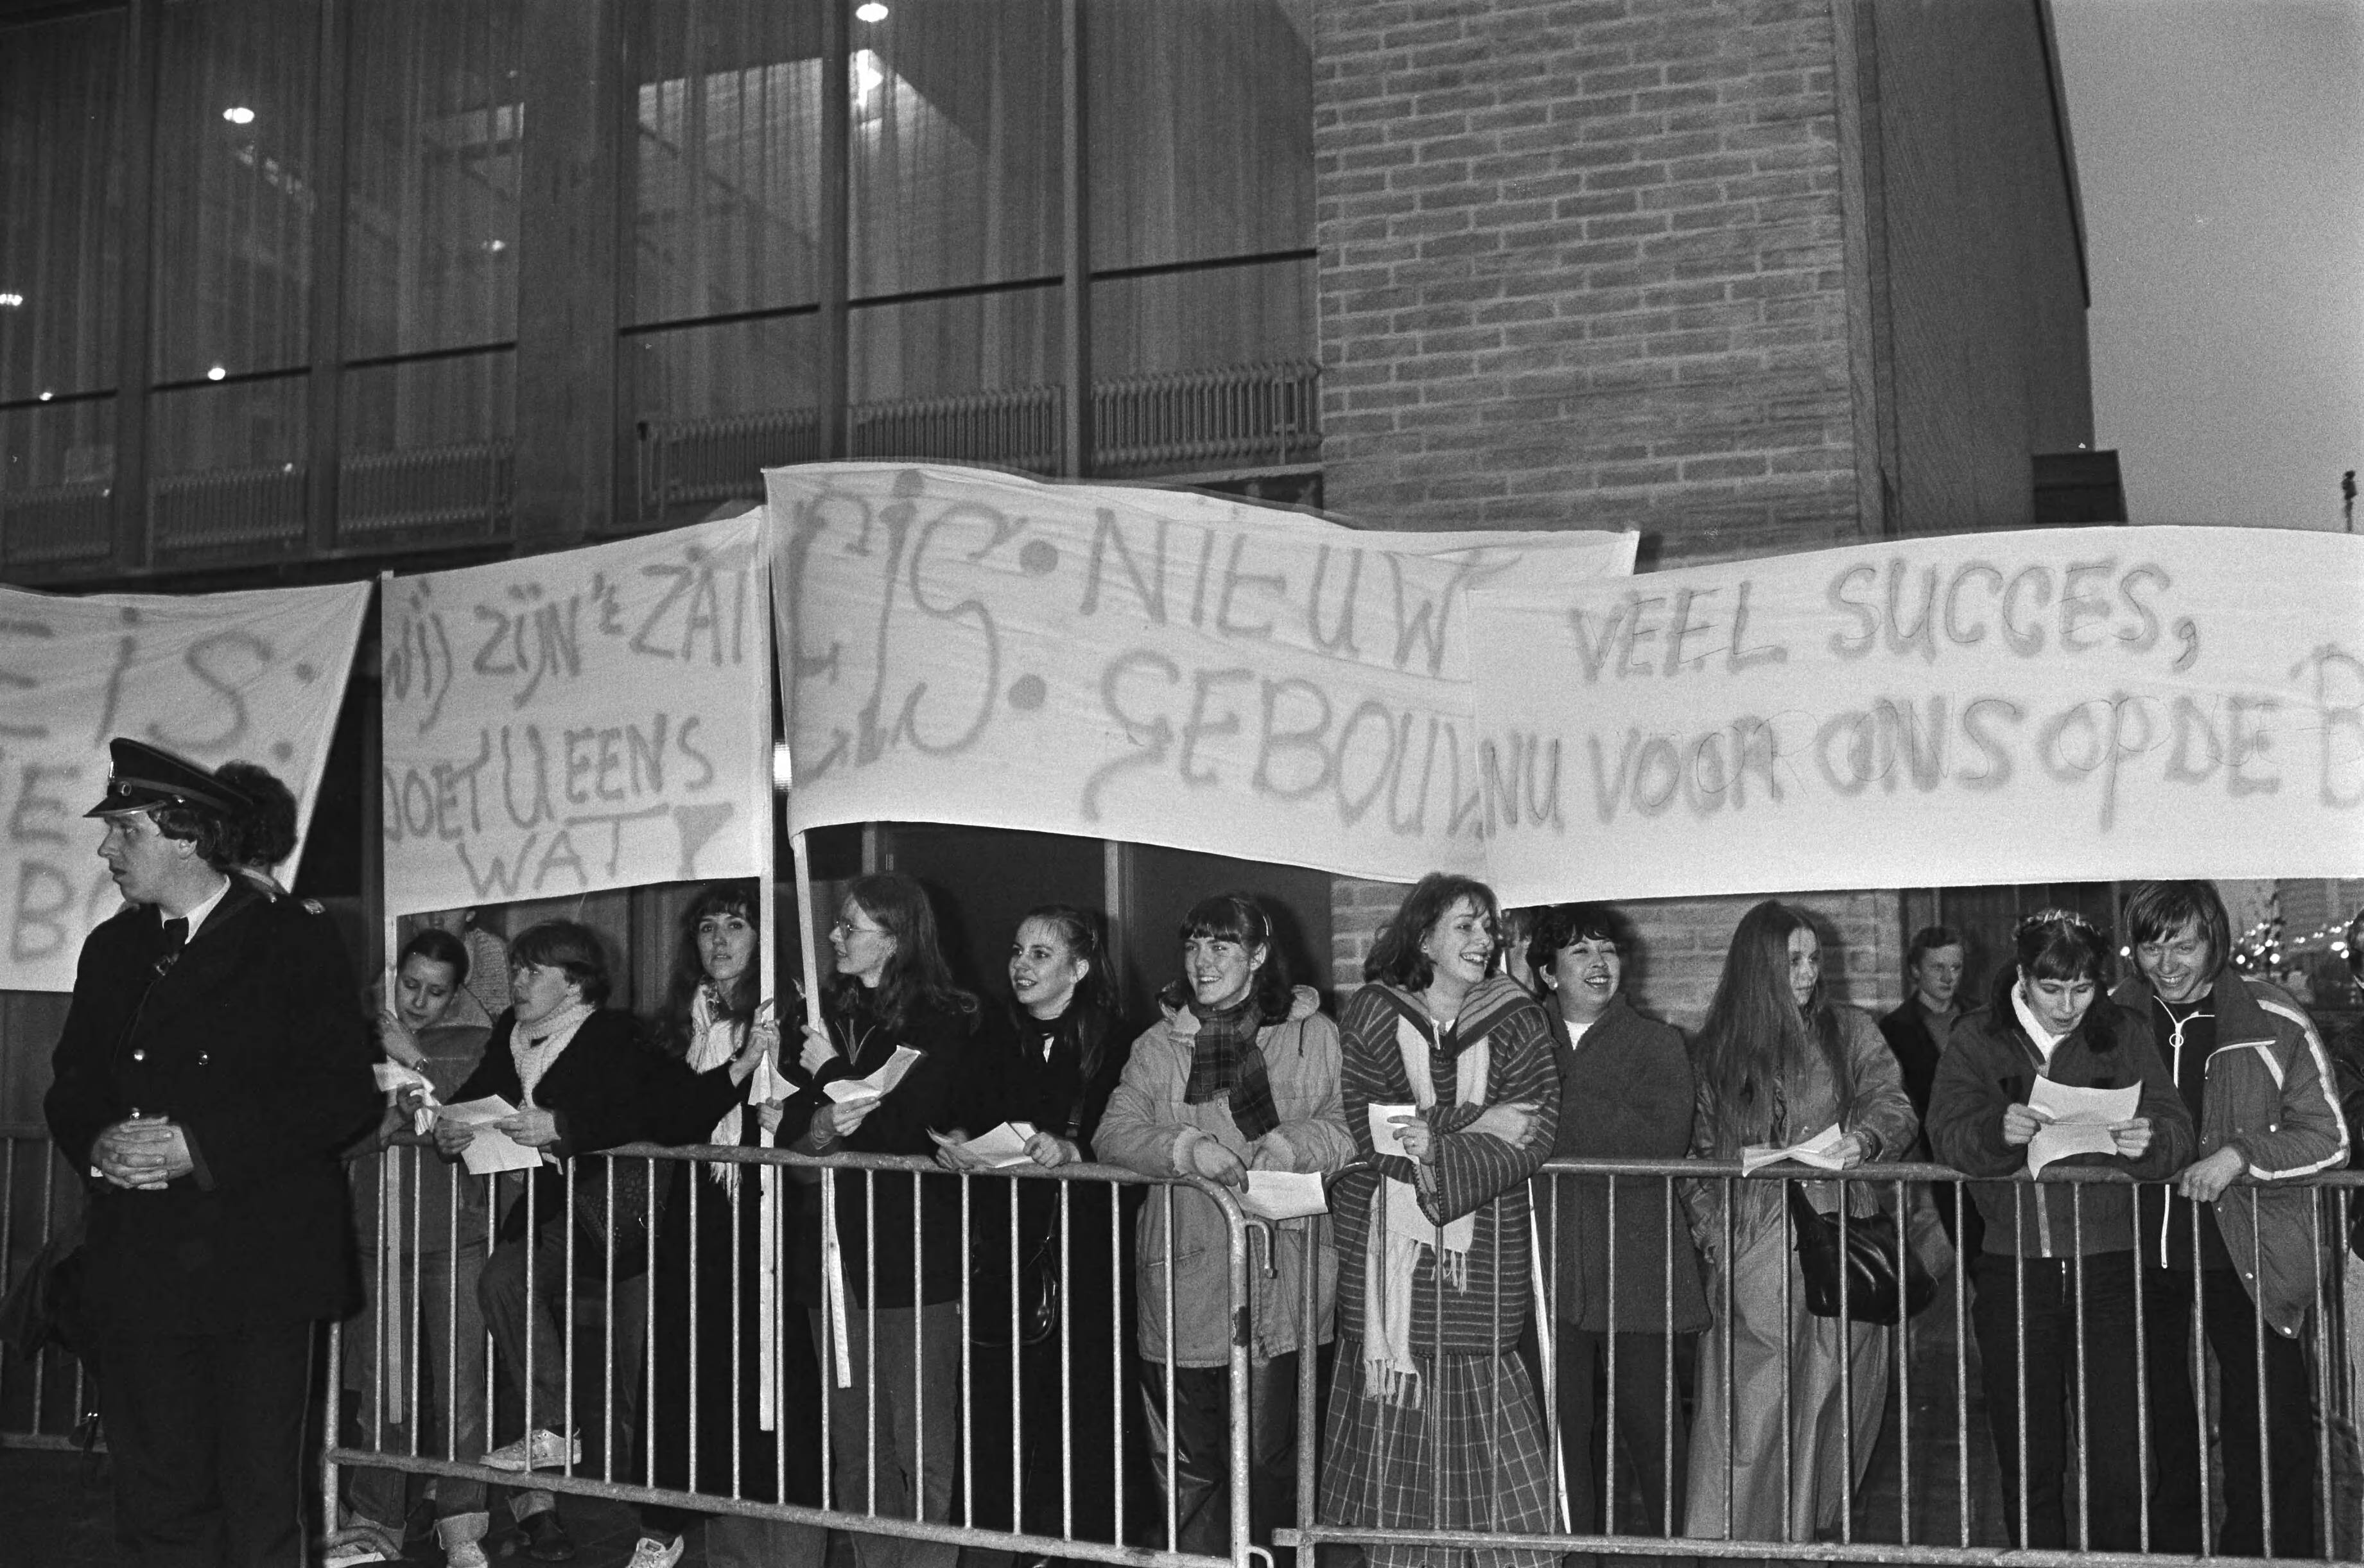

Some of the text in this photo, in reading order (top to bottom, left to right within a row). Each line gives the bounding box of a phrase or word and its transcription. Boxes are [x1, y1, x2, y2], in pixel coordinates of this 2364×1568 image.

[1080, 507, 1523, 677] NIEUW
[1568, 557, 2198, 683] VEEL SUCCES,
[562, 711, 710, 804] EENS
[1479, 729, 1564, 837] NU
[1587, 714, 1784, 824] VOOR
[1816, 695, 2026, 794] ONS
